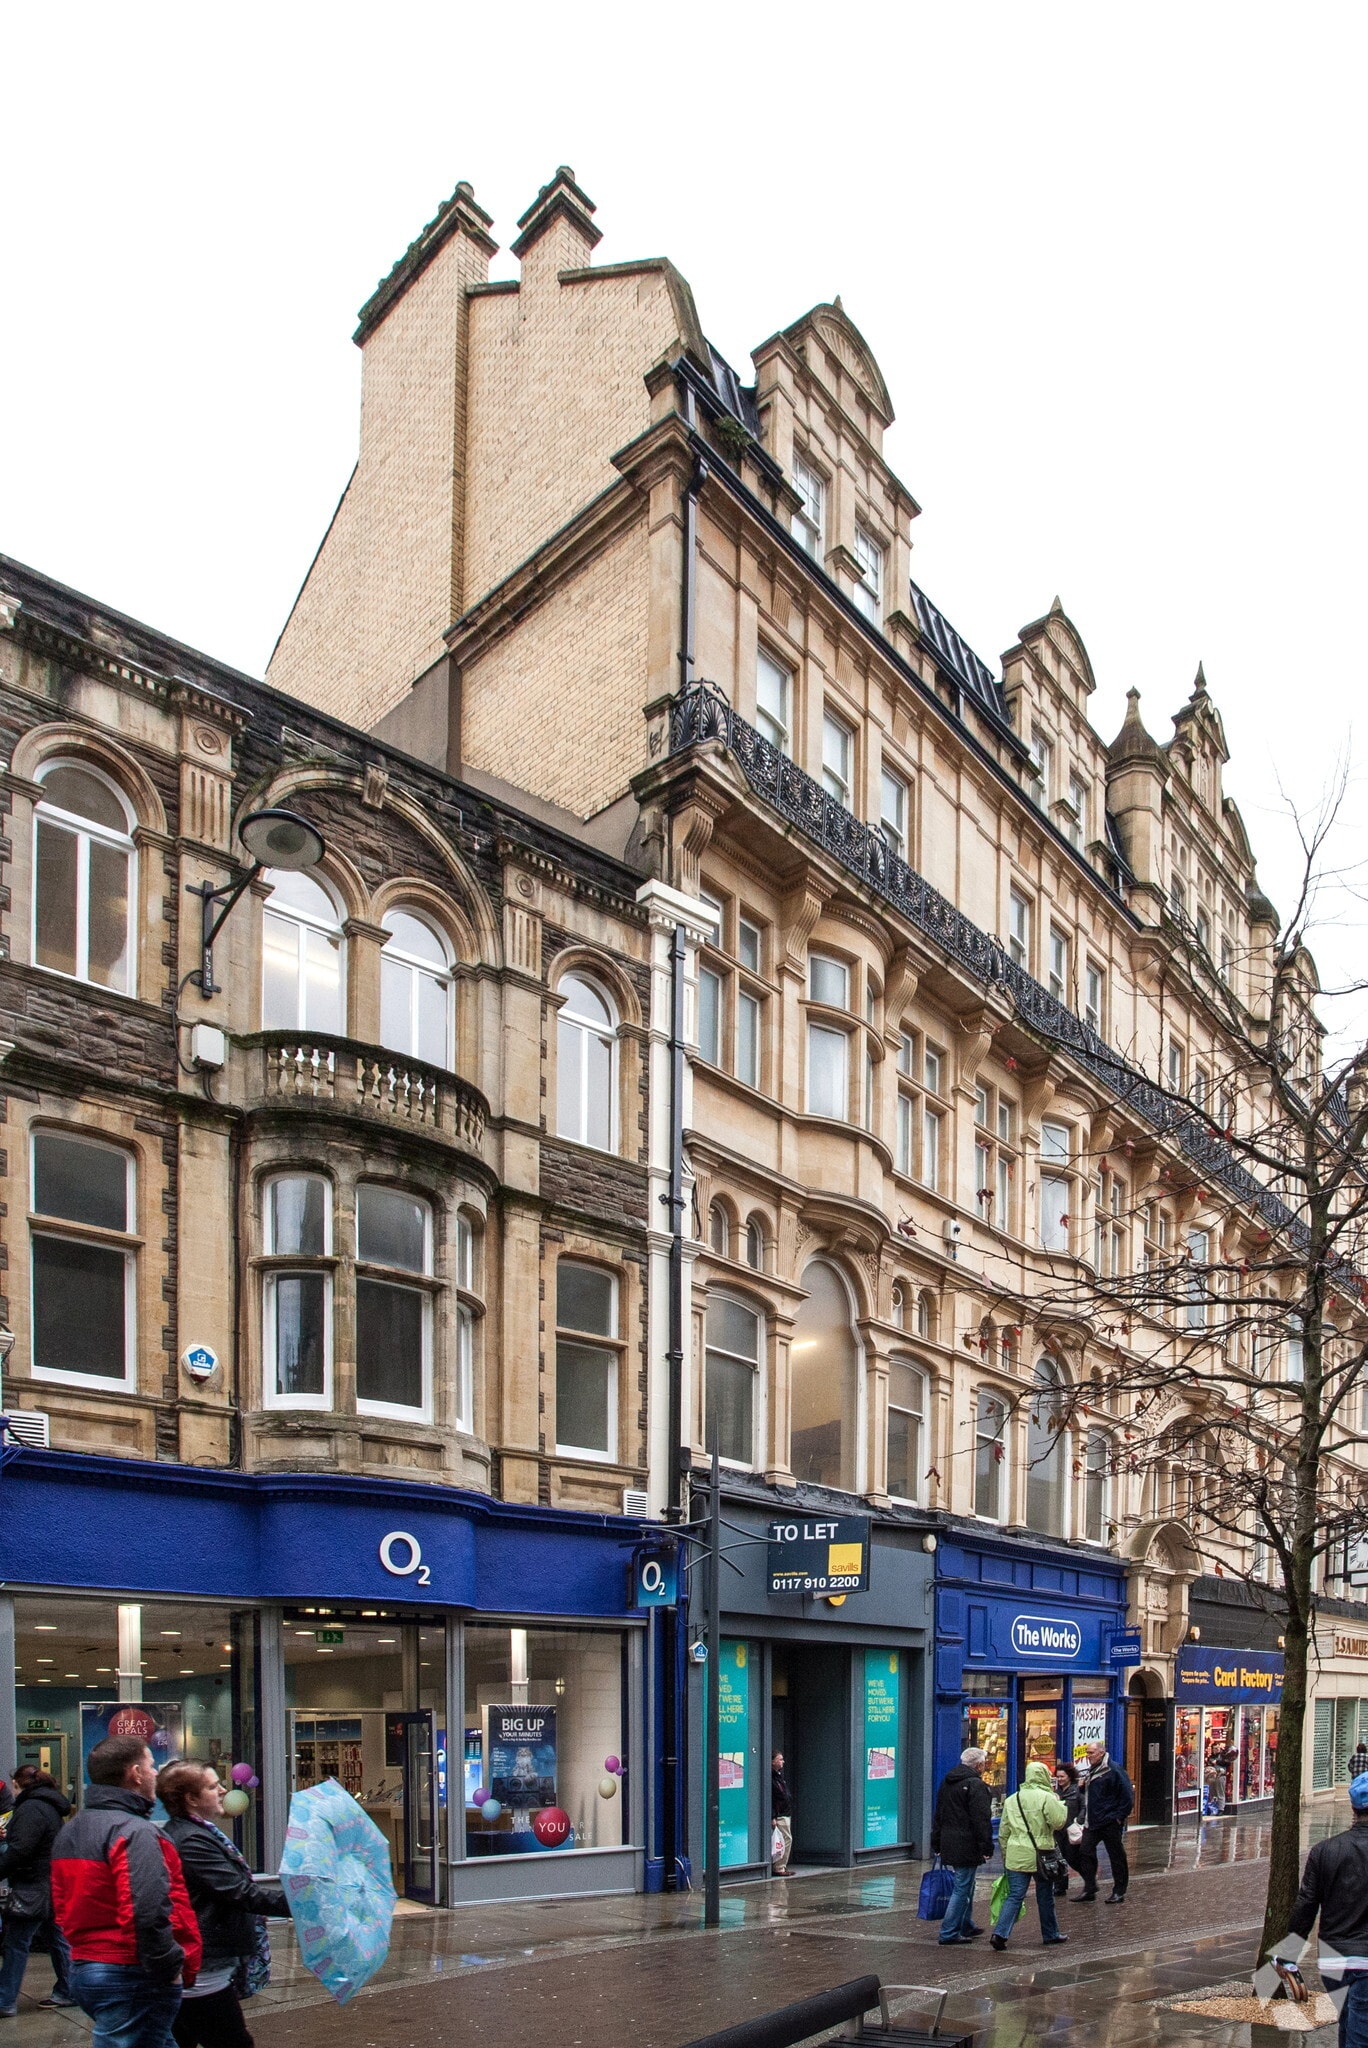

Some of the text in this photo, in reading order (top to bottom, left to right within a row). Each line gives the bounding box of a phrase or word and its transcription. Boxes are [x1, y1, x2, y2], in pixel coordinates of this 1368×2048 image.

[773, 1523, 839, 1542] TO LET
[379, 1530, 432, 1586] O2
[831, 1563, 859, 1573] savills
[641, 1561, 666, 1596] O2
[772, 1576, 859, 1590] 0117 910 2200
[1017, 1624, 1077, 1649] The Works
[1214, 1666, 1273, 1692] Card Factory
[1076, 1708, 1105, 1721] MASSIVE
[117, 1727, 148, 1735] DEALS
[502, 1718, 545, 1731] BIG UP
[1078, 1726, 1101, 1740] STOCK
[510, 1816, 530, 1824] THE
[539, 1823, 566, 1833] YOU
[568, 1832, 593, 1841] SALE
